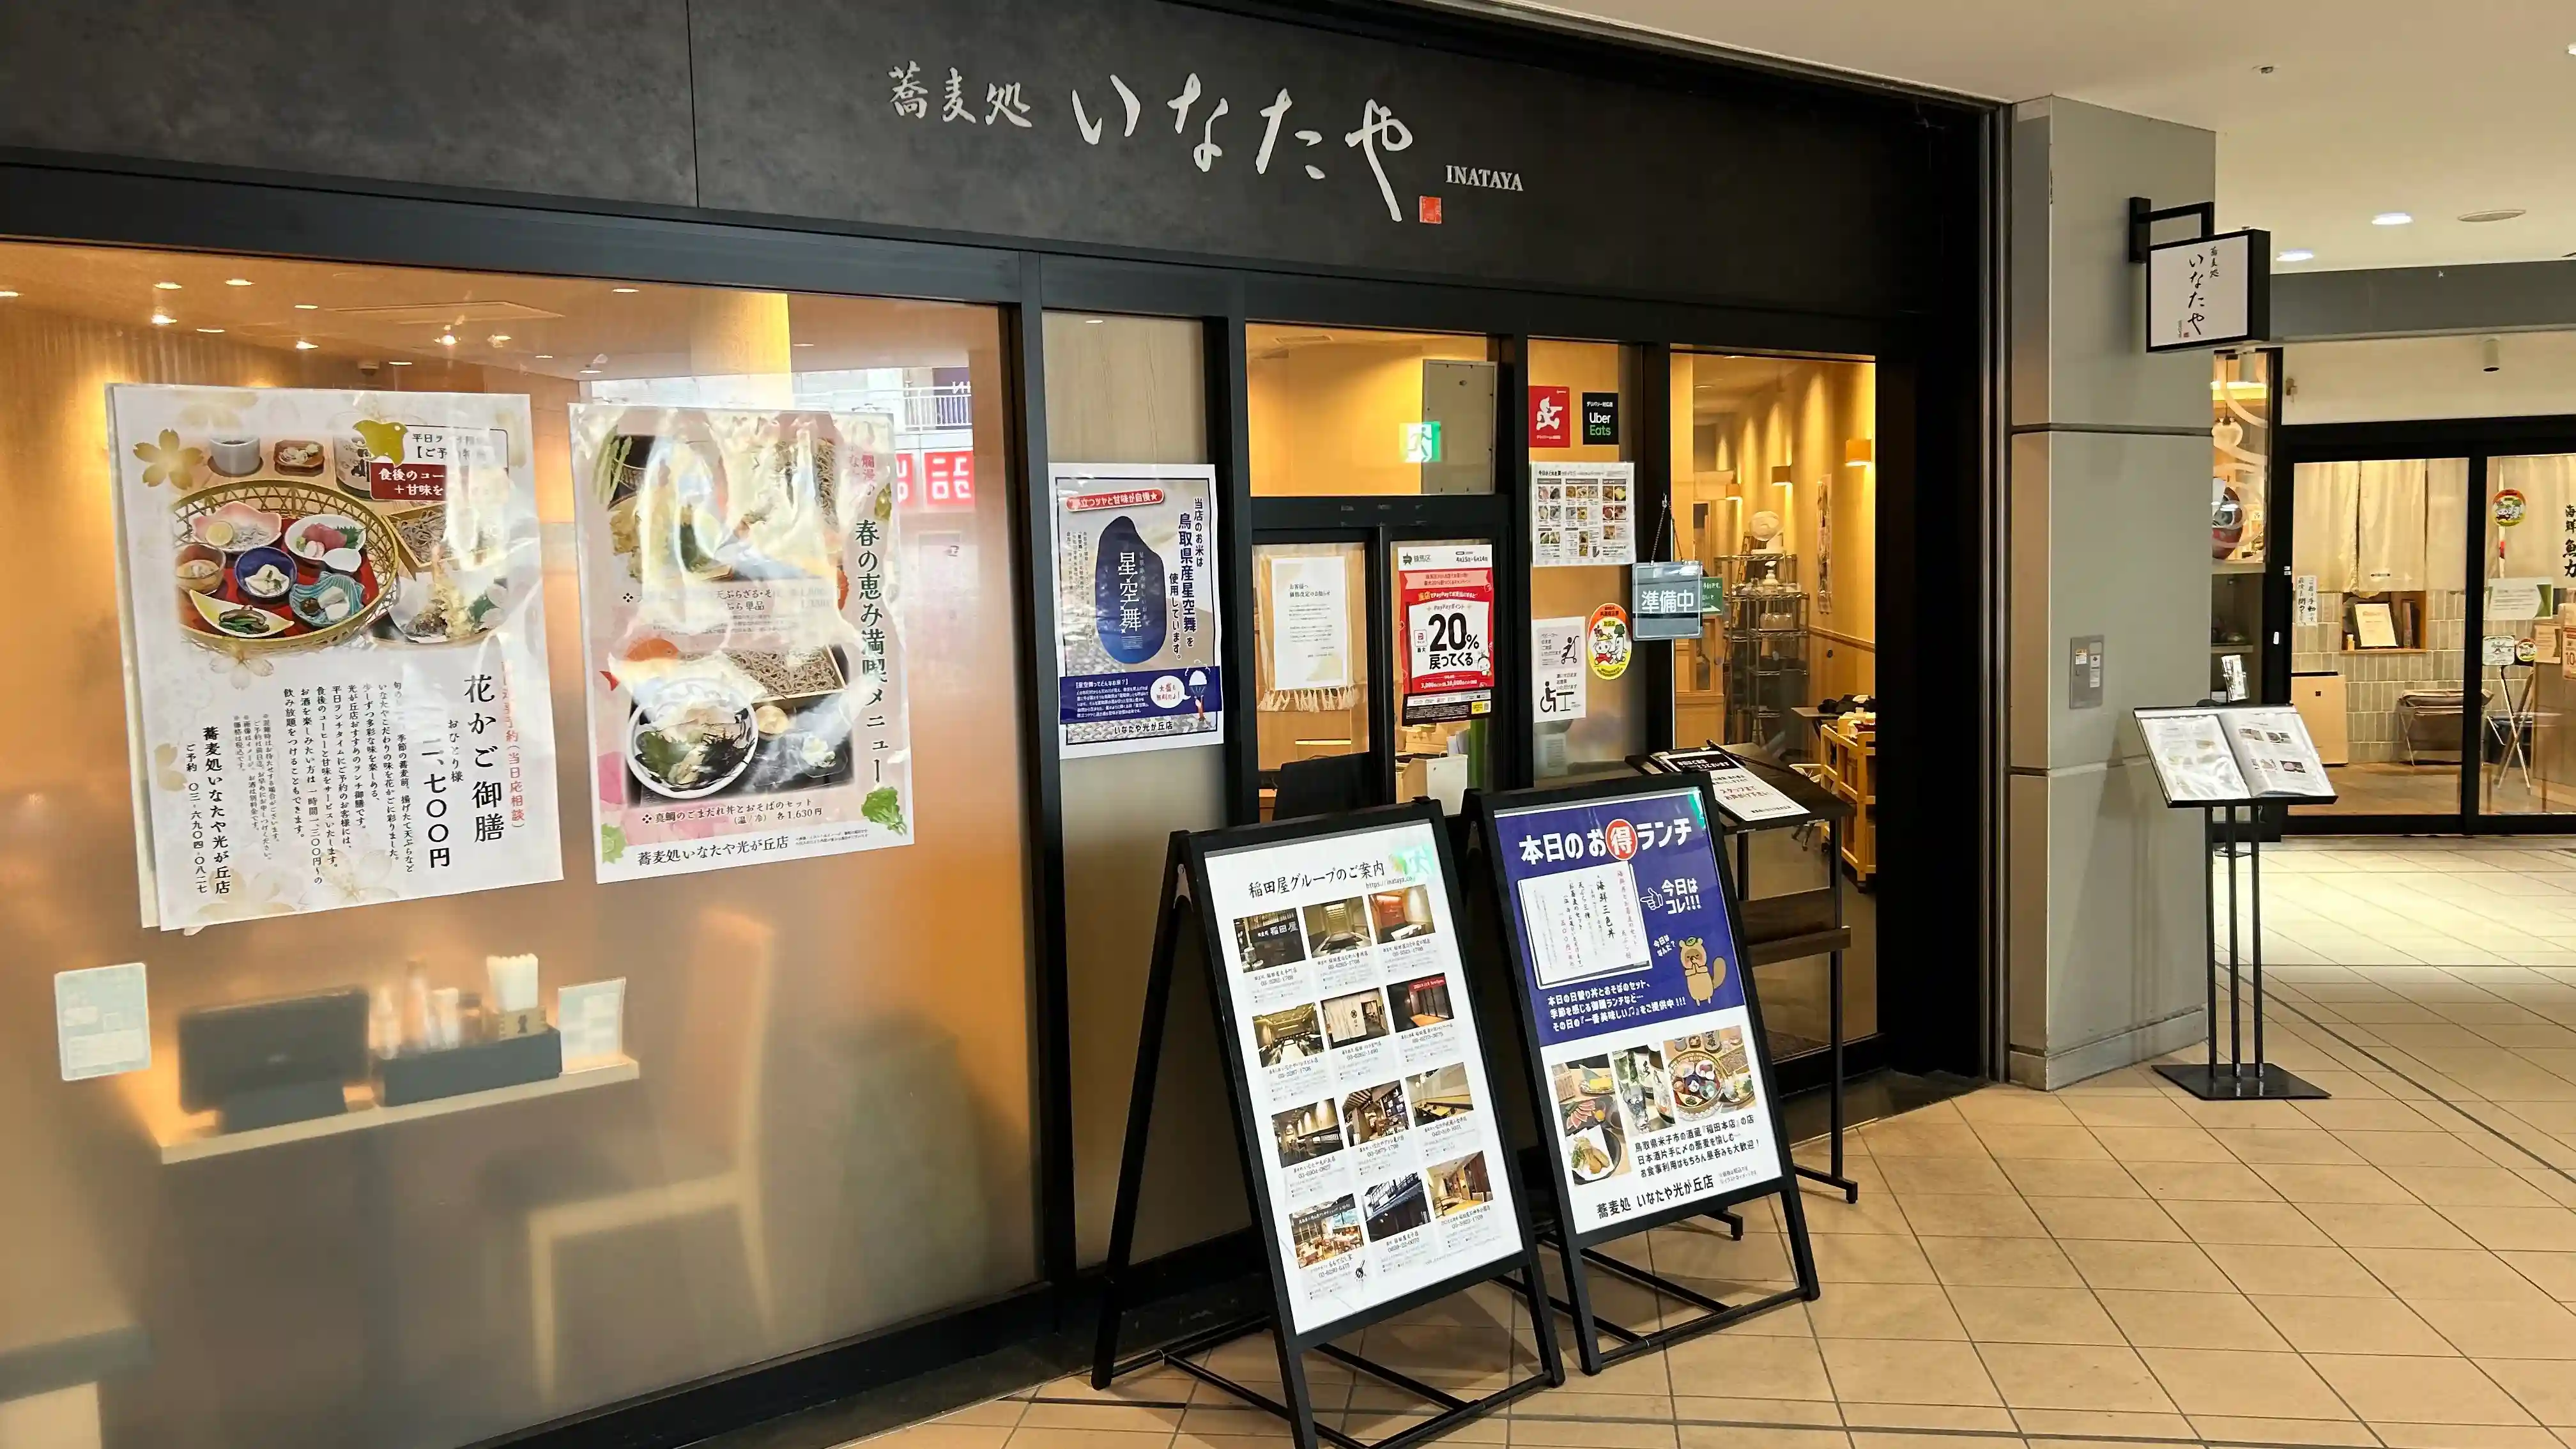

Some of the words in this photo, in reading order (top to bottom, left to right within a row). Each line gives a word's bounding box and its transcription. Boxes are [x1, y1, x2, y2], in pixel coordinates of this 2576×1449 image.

[889, 61, 1032, 127] 蕎麦処
[1071, 73, 1413, 222] いなたや
[1445, 165, 1524, 192] INATAYA
[2187, 254, 2205, 335] いなたや
[1589, 412, 1611, 424] Uber
[1590, 425, 1611, 436] Eats
[1193, 498, 1204, 567] 当店のお米は
[1169, 572, 1182, 661] 使用しています。
[1641, 589, 1694, 613] 準備中
[1428, 612, 1480, 652] 20%
[1429, 652, 1473, 670] 戻ってくる
[1114, 721, 1174, 735] いなたや光が丘店
[186, 743, 197, 772] ご予約
[448, 719, 464, 783] おひとり様
[463, 673, 505, 844] 花かご御膳
[202, 726, 231, 894] 蕎麦処いなたや光が丘店
[655, 798, 813, 824] 真鯛のごまだれ丼とおそばのセット
[638, 835, 790, 866] 蕎麦処いなたや光が丘店
[1248, 860, 1385, 899] 稲田屋グループのご案内
[1661, 878, 1698, 896] 今日は
[1597, 1196, 1632, 1220] 蕎麦処
[1636, 1174, 1715, 1207] いなたや光が丘店
